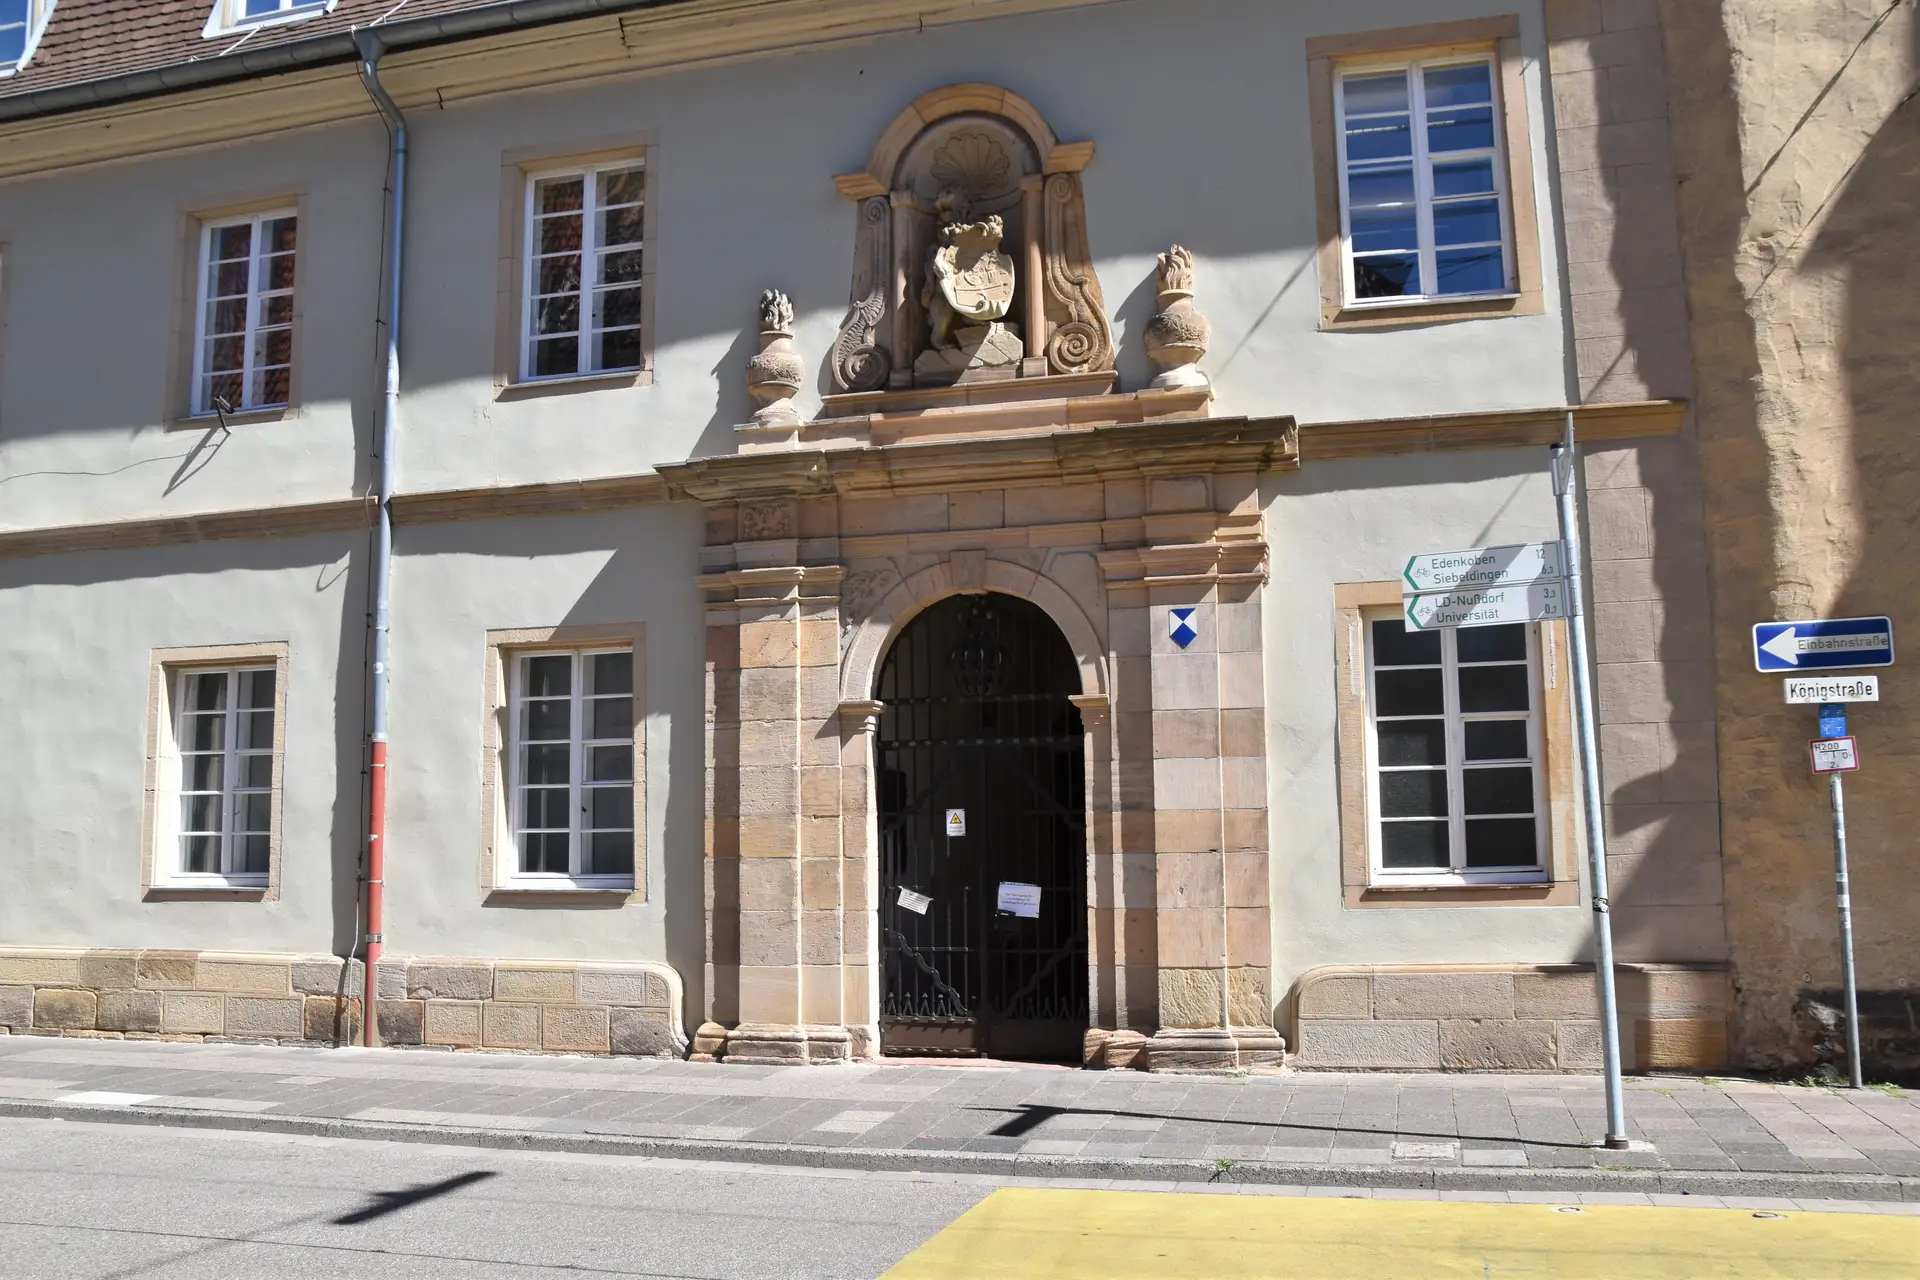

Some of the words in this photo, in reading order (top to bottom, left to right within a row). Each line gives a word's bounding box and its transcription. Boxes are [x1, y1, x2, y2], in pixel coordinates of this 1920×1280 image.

[1431, 555, 1496, 569] Edenkoben
[1536, 548, 1546, 559] 12
[1433, 569, 1509, 585] Siebeldingen
[1435, 592, 1505, 608] LD-Nußdorf
[1436, 608, 1499, 623] Universität
[1798, 635, 1889, 650] Einbahnstraße
[1789, 681, 1873, 701] Königstraße
